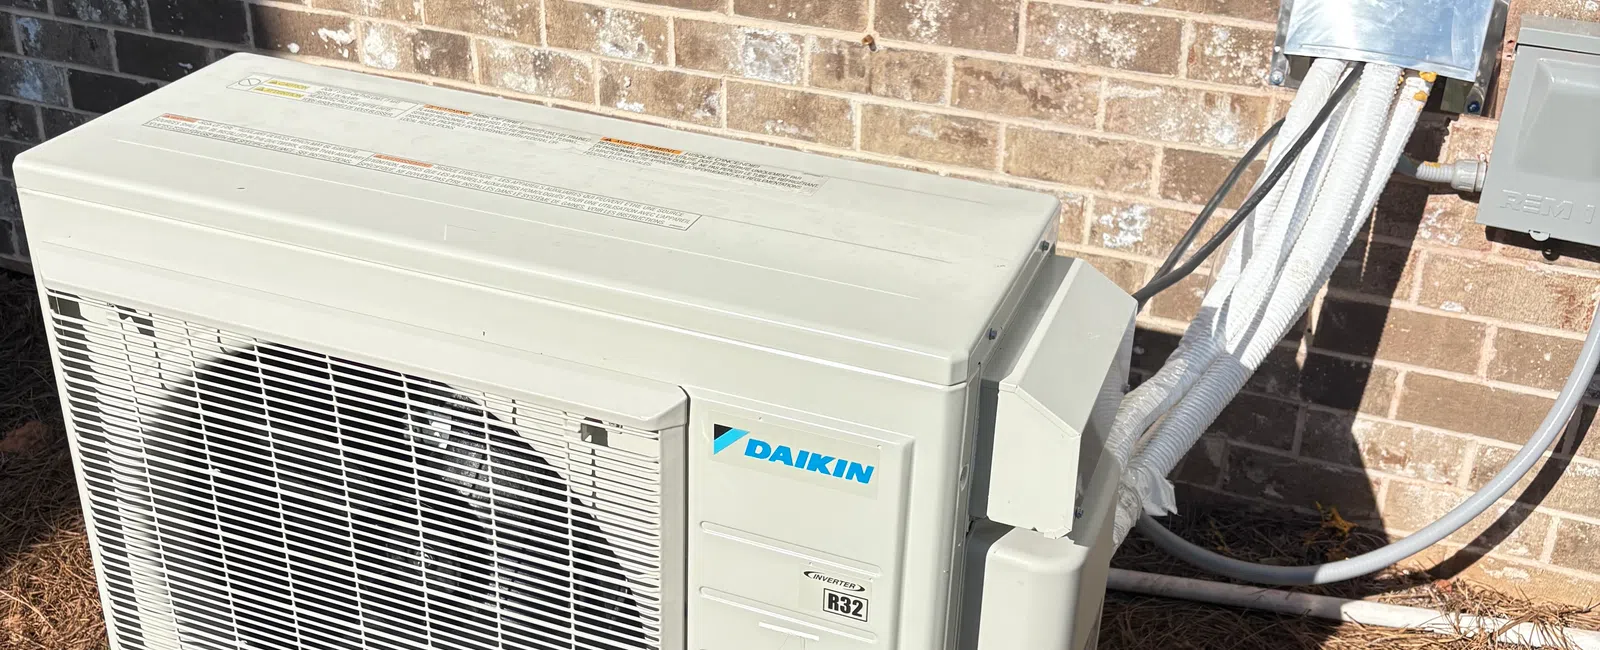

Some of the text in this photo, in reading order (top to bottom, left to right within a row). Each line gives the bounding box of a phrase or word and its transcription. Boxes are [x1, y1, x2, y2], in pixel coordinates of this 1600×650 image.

[1500, 189, 1574, 221] REM
[744, 438, 874, 484] DAIKIN
[812, 573, 857, 590] INVERTER
[827, 592, 863, 618] R32
